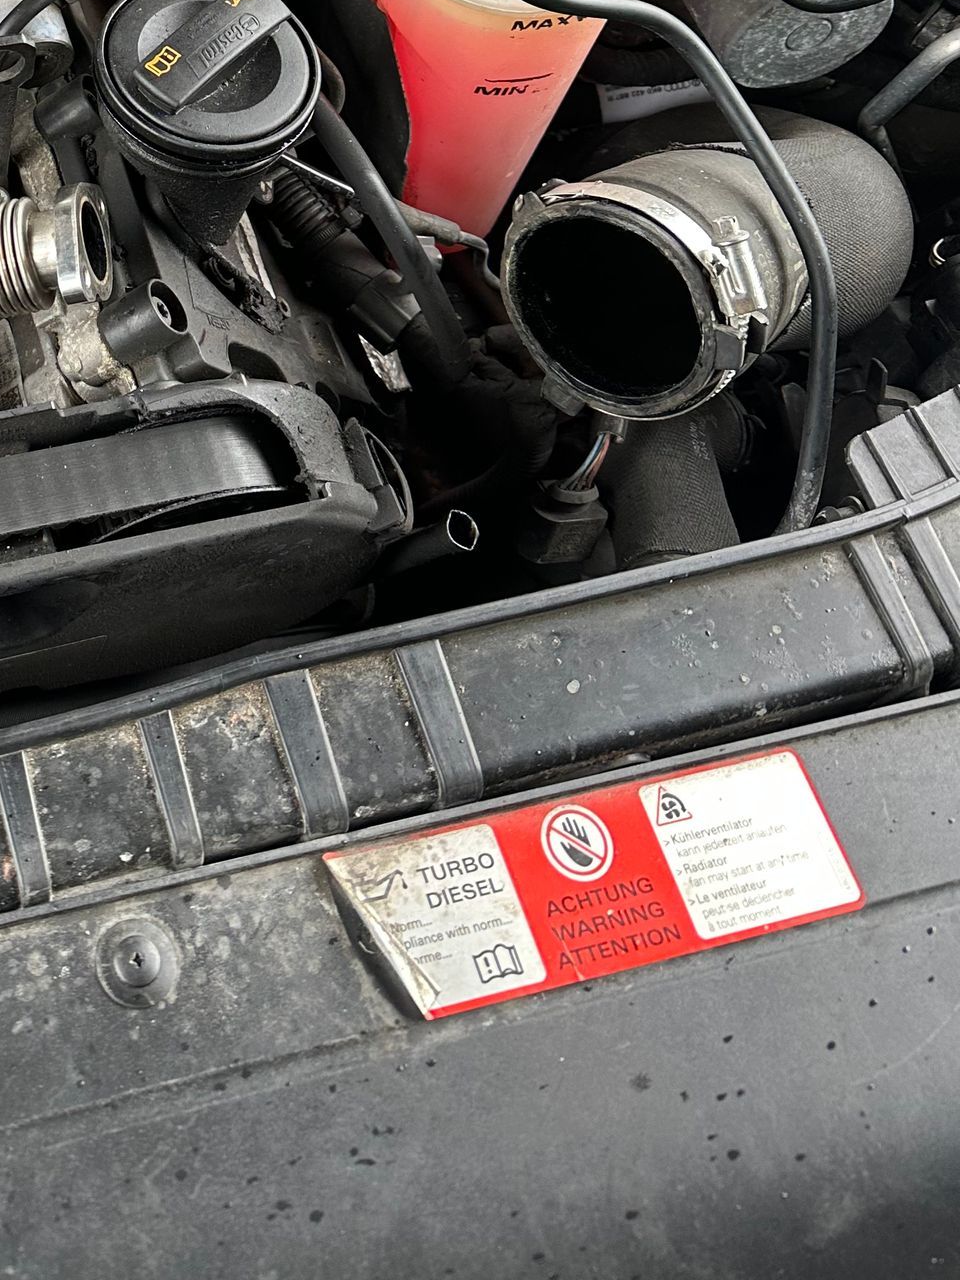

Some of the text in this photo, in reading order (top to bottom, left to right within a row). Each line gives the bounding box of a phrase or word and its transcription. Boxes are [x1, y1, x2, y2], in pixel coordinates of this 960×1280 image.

[511, 15, 573, 31] MAX
[199, 23, 246, 69] Castrol
[474, 84, 529, 96] MIN
[671, 817, 753, 846] Kühlerventilator
[676, 843, 701, 858] kann
[702, 833, 744, 855] jederzeit
[417, 852, 495, 884] TURBO
[683, 855, 729, 875] Radiator
[707, 870, 730, 885] may
[731, 864, 754, 878] start
[755, 860, 766, 872] at
[426, 878, 505, 909] DIESEL
[546, 876, 655, 918] ACHTUNG
[695, 878, 768, 906] Le ventilateur
[445, 925, 471, 939] with
[551, 901, 665, 942] WARNING
[717, 914, 738, 930] tout
[558, 923, 682, 970] ATTENTION
